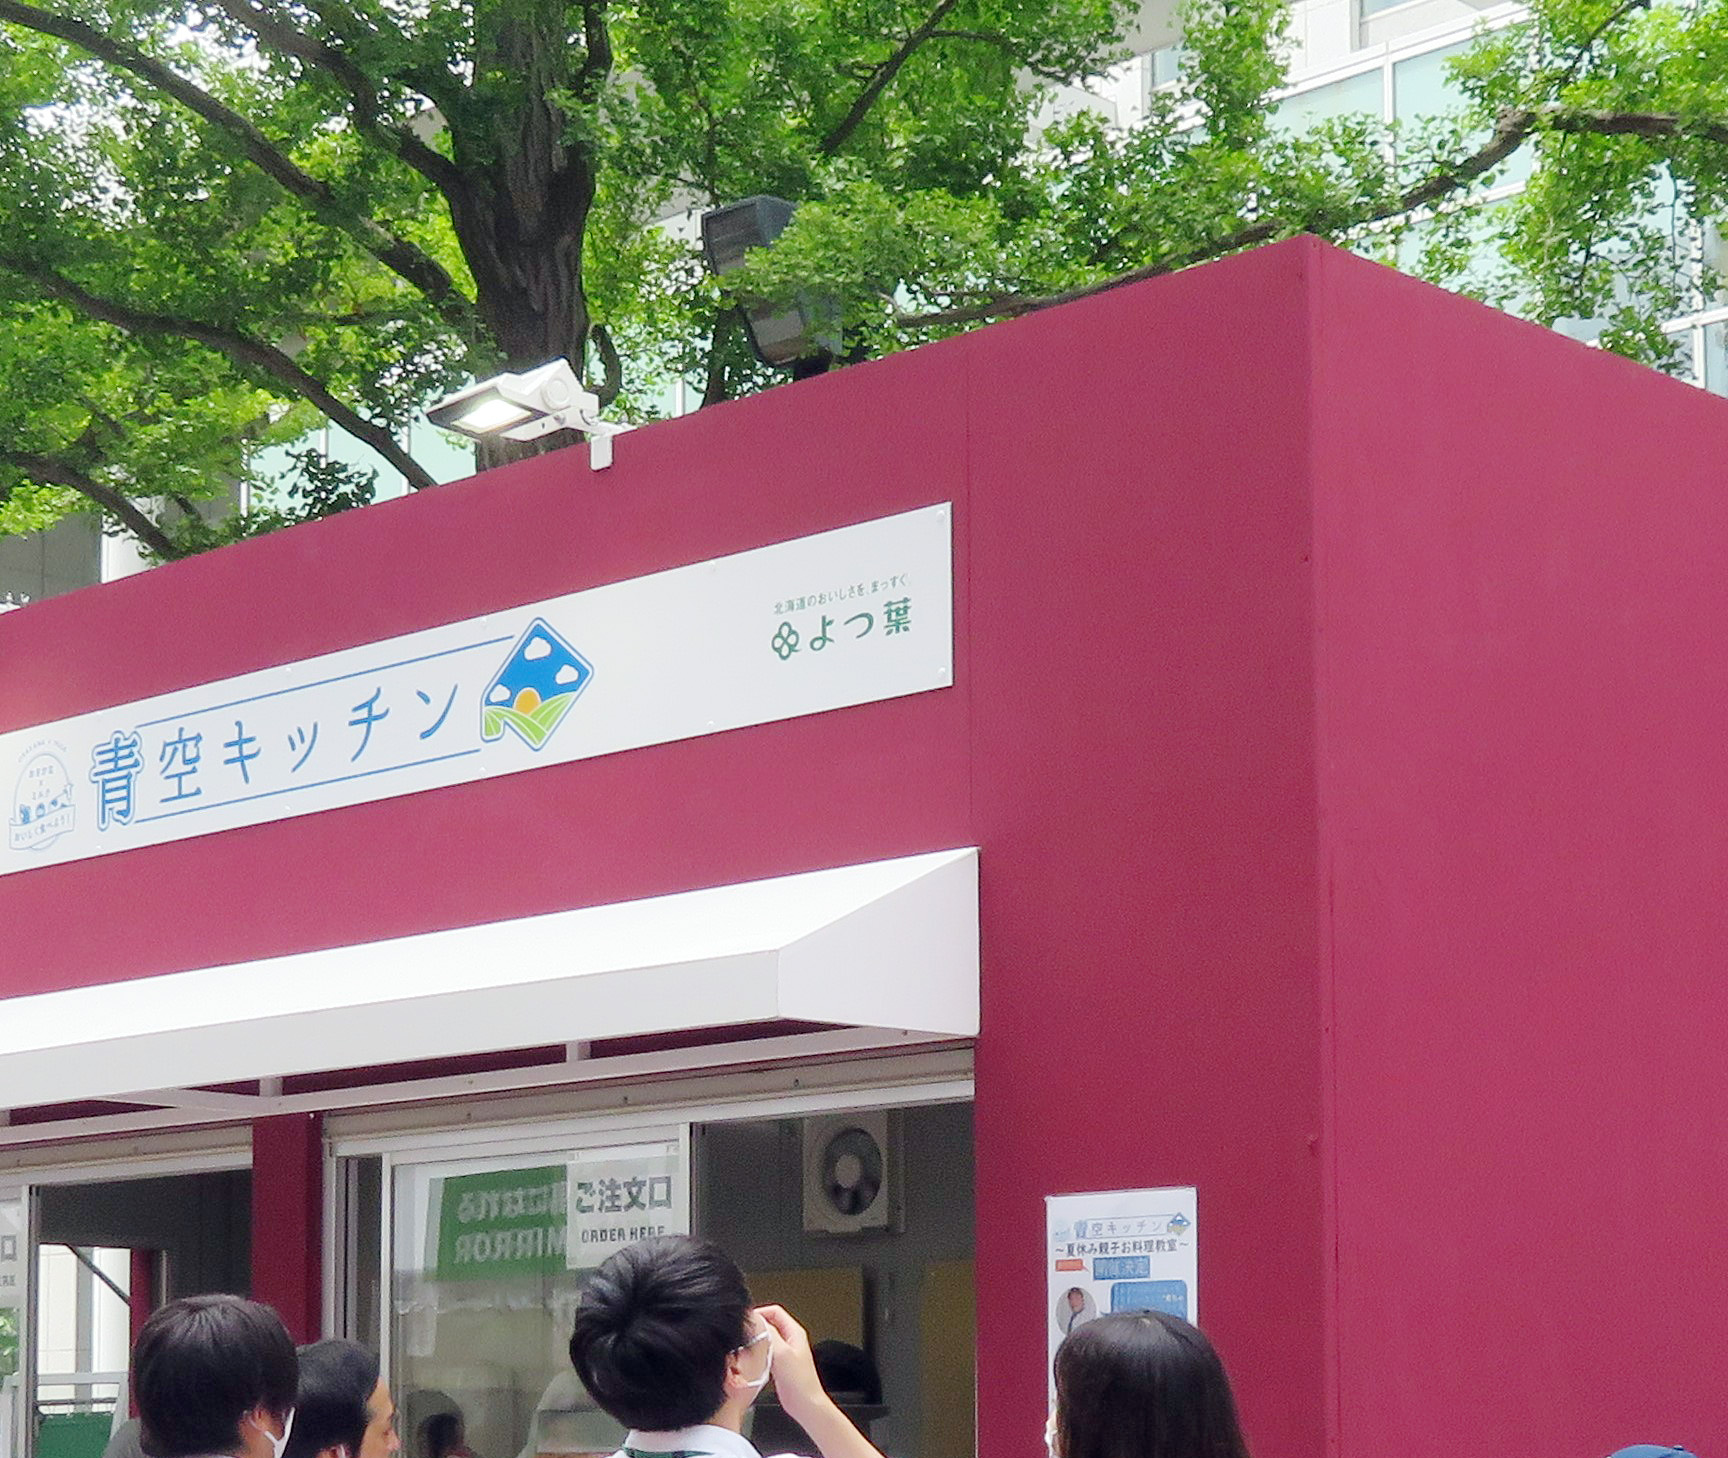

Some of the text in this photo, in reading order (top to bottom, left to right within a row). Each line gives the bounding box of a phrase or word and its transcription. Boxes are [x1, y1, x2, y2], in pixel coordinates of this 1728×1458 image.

[809, 597, 912, 652] よつ葉
[90, 684, 459, 831] 青空キッチン
[575, 1175, 672, 1215] ご注文口
[581, 1226, 627, 1244] ORDER
